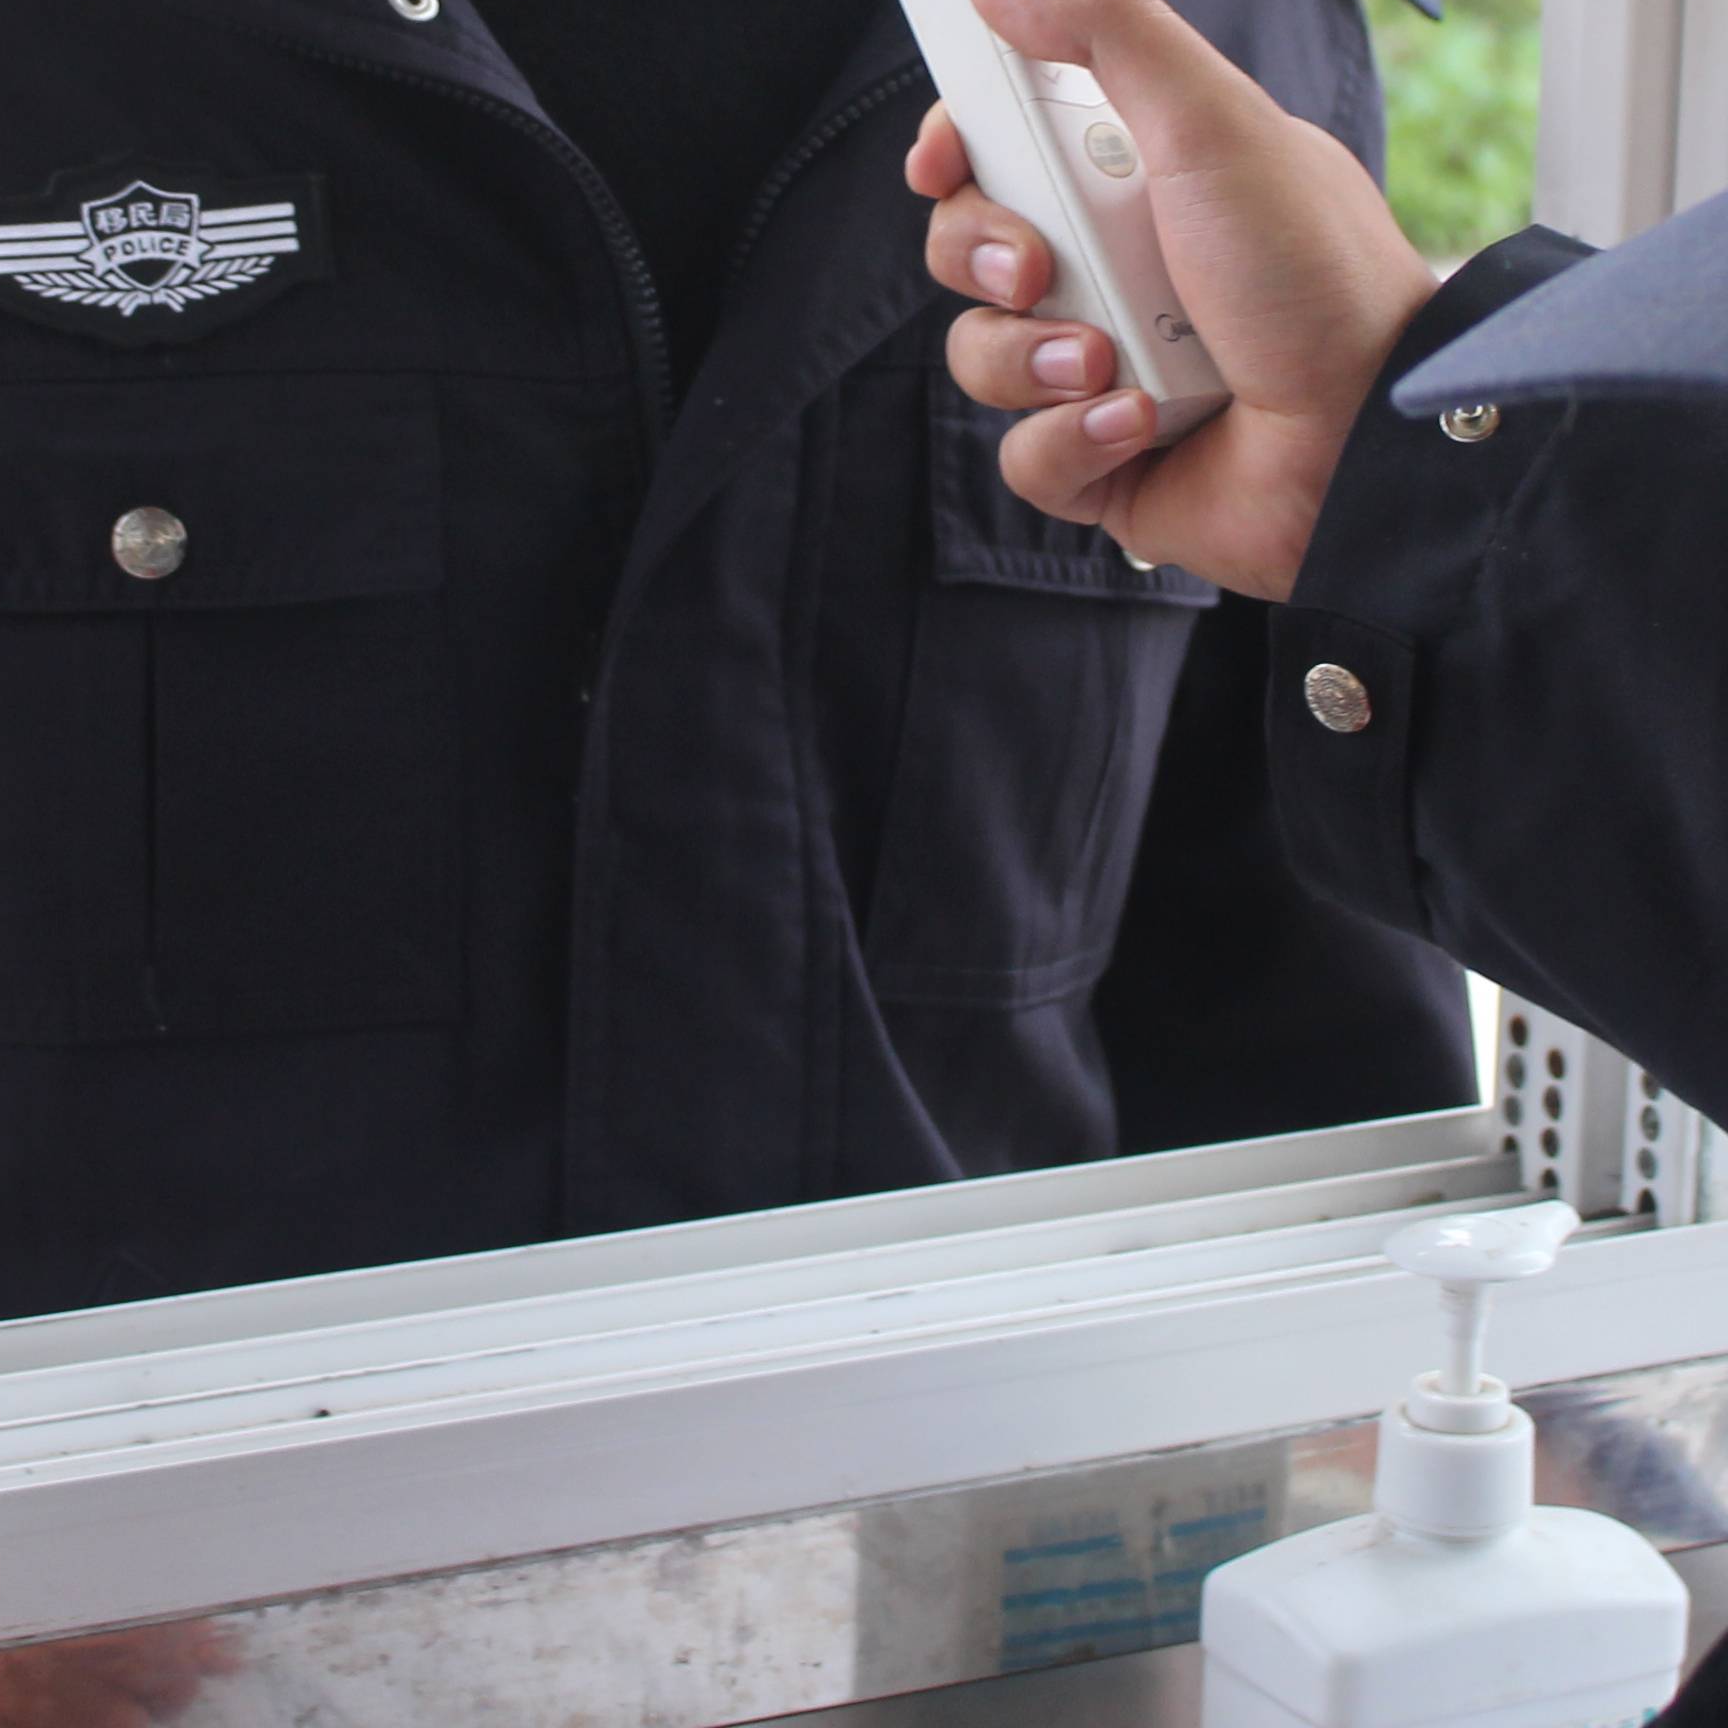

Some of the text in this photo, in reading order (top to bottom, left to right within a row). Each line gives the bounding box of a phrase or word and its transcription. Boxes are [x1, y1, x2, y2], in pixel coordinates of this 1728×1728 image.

[96, 202, 191, 233] 移民局
[104, 237, 190, 260] POLICE
